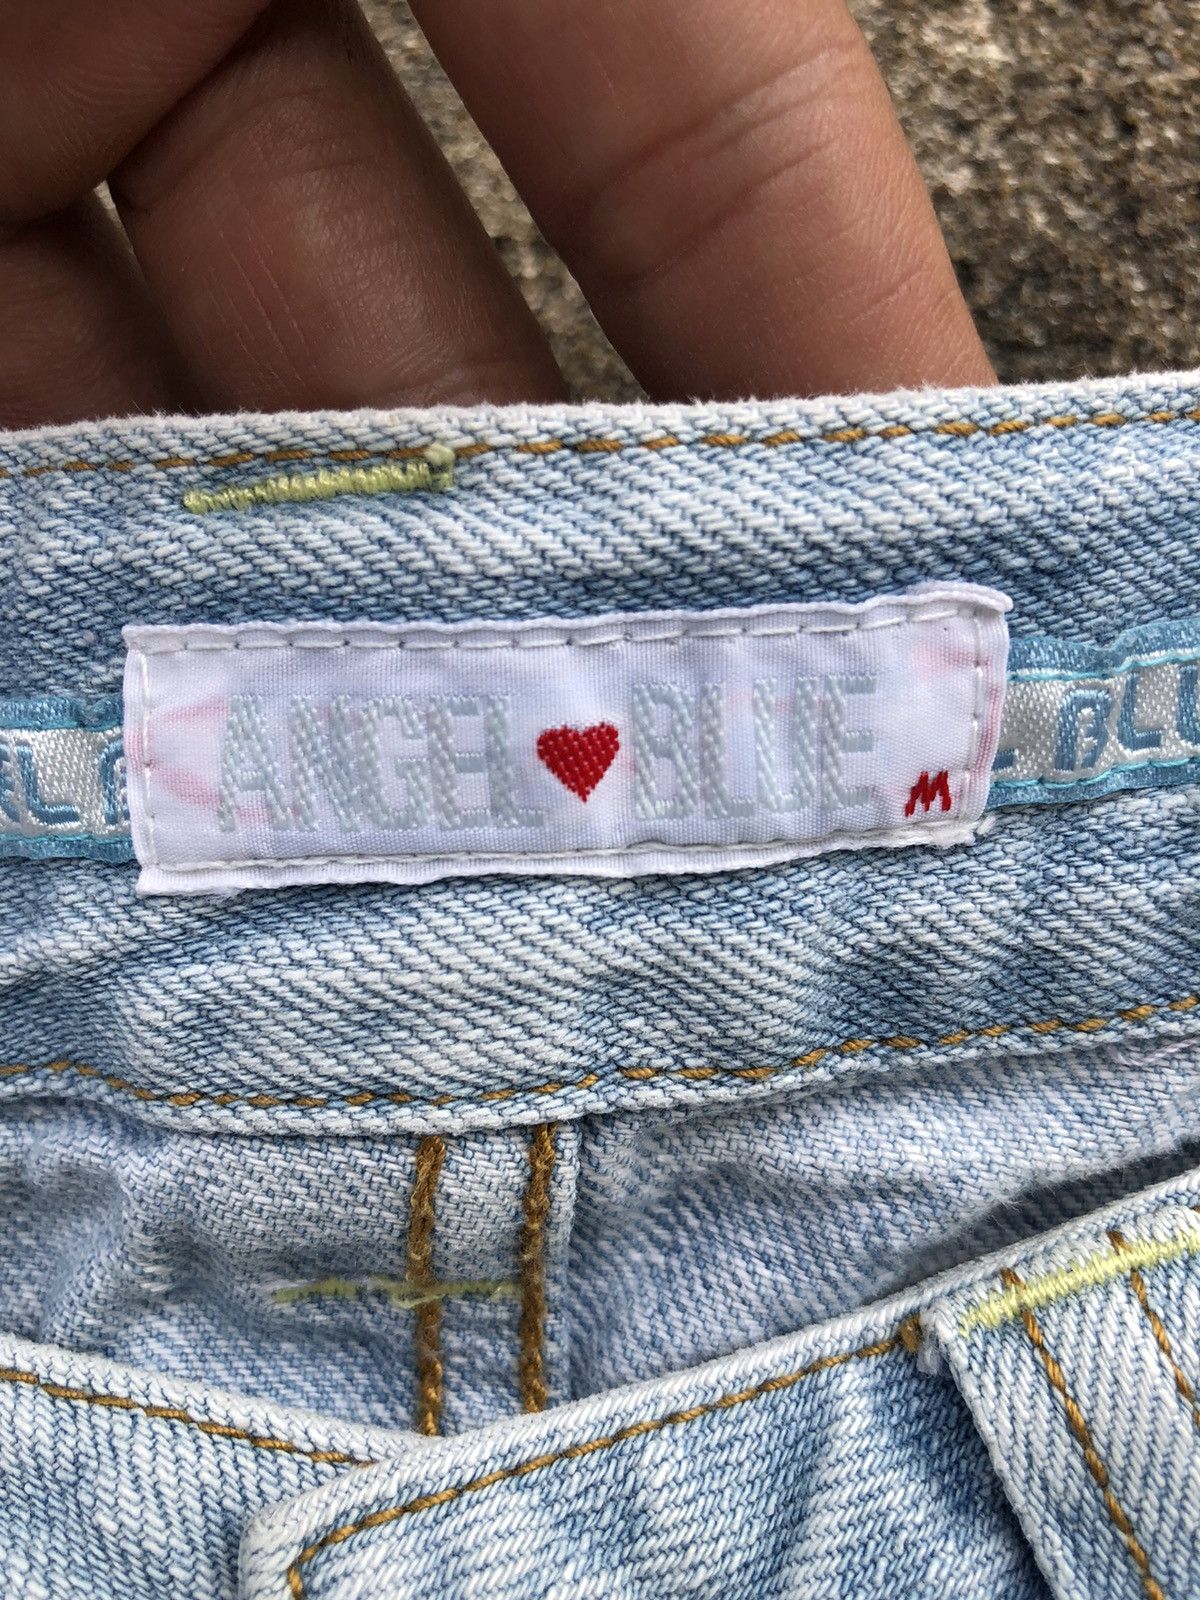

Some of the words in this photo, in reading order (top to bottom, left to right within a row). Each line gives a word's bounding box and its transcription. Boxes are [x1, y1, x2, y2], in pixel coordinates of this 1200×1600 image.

[219, 694, 544, 832] ANGEL
[632, 674, 878, 820] BLUE
[904, 770, 952, 817] M
